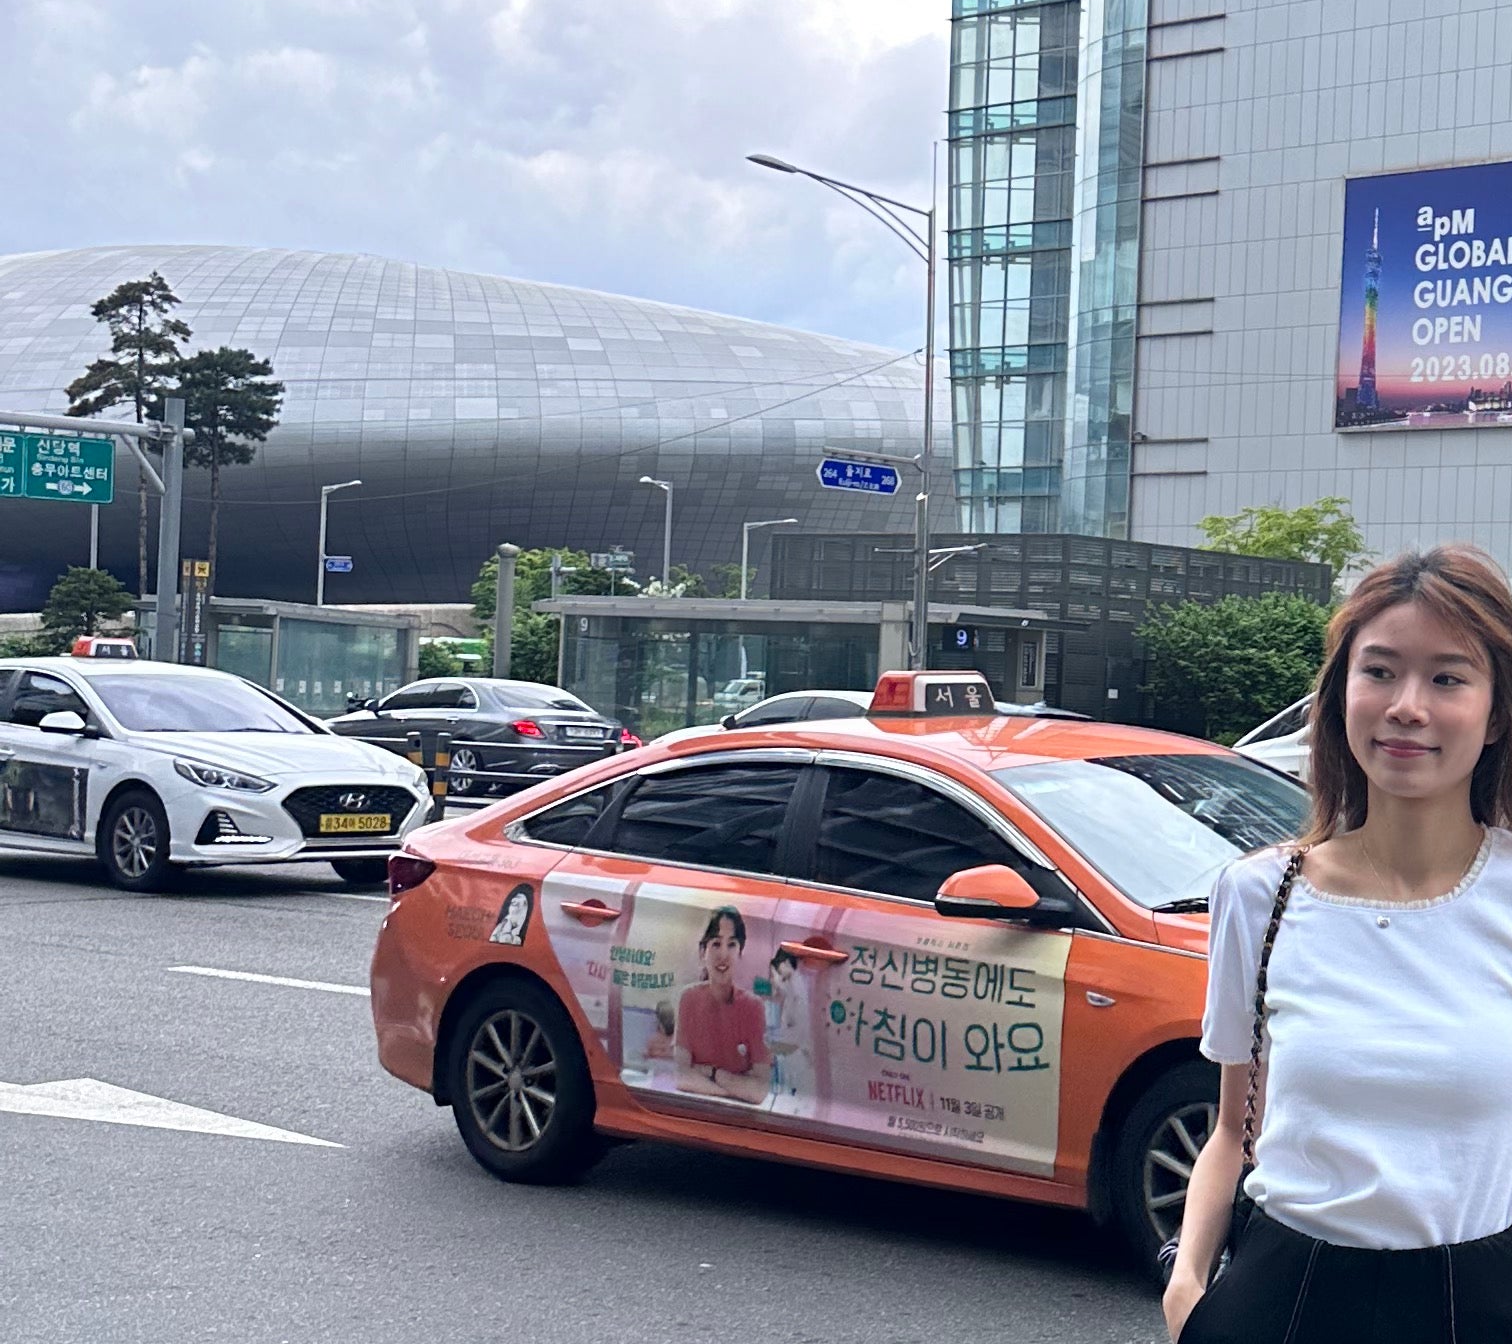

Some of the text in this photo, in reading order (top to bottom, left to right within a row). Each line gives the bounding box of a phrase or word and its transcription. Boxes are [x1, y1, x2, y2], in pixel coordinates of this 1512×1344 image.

[1416, 205, 1476, 242] apM
[1411, 314, 1482, 346] OPEN
[37, 439, 82, 457] 신당역
[31, 462, 108, 481] 충무아트센터
[580, 617, 589, 632] 9
[956, 629, 968, 646] 9
[935, 685, 983, 709] 서울
[358, 816, 387, 830] 5028
[849, 944, 1038, 1010] 정신병동에도
[964, 1021, 1051, 1074] 와요
[867, 1080, 926, 1111] NETFLIX
